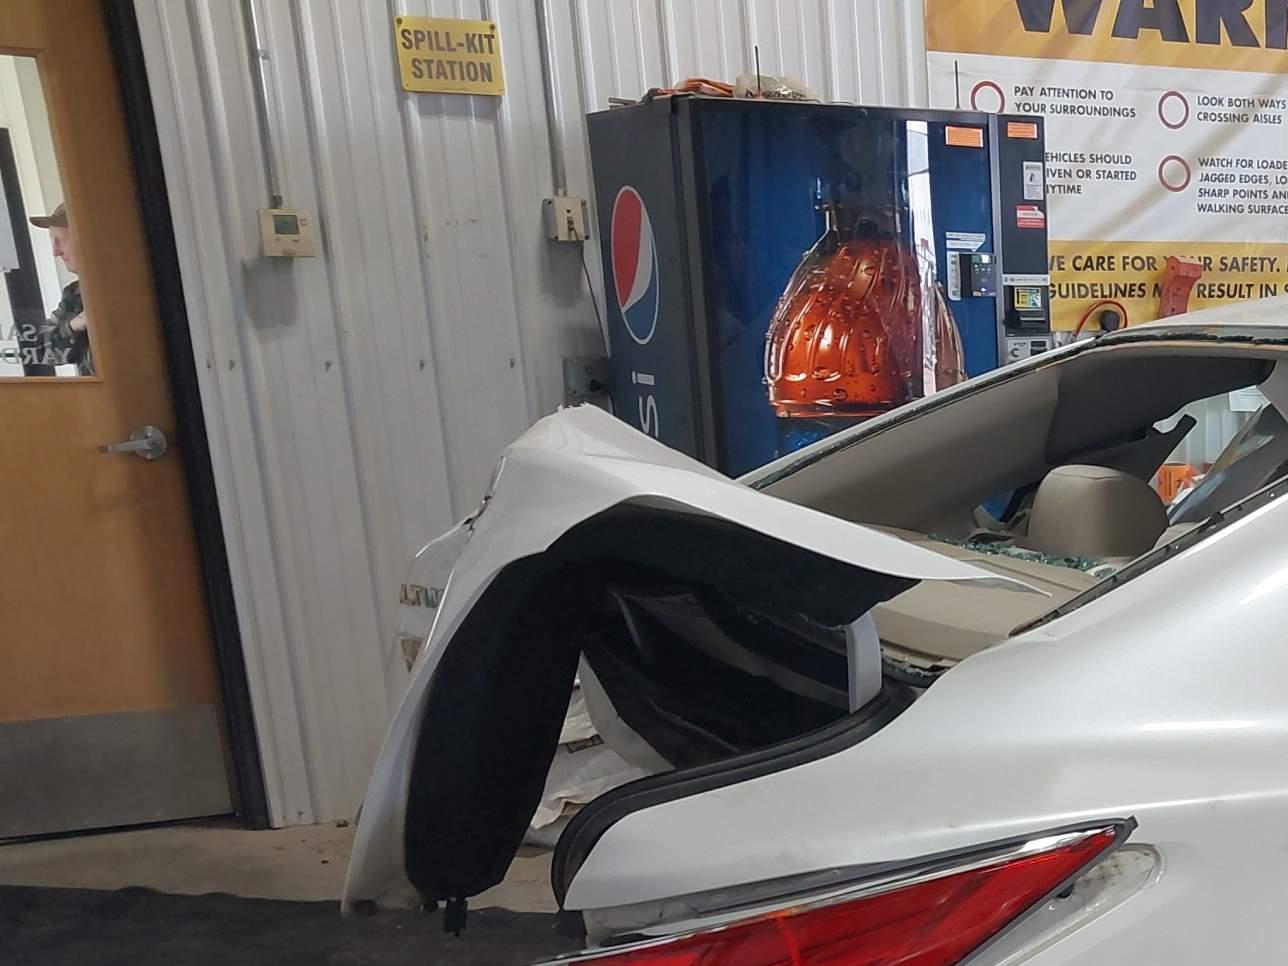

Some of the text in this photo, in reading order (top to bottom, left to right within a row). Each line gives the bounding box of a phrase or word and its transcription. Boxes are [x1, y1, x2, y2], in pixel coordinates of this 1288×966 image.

[401, 29, 495, 54] SPILL-KIT
[411, 58, 493, 82] STATION
[1014, 86, 1114, 100] PAY ATTENTION TO
[1197, 96, 1224, 107] LOOK
[1228, 98, 1255, 108] BOTH
[1258, 99, 1287, 109] WAYS
[1014, 102, 1136, 117] YOUR SURROUNDINGS
[1197, 111, 1282, 124] CROSSING AISLES
[1089, 153, 1132, 164] SHOULD
[1198, 157, 1233, 168] WATCH
[1235, 158, 1253, 168] FOR
[1076, 169, 1092, 179] OR
[1095, 170, 1137, 180] STARTED
[1199, 172, 1236, 183] JAGGED
[1239, 174, 1272, 186] EDGES,
[1198, 187, 1229, 198] SHARP
[1232, 189, 1268, 199] POINTS
[1197, 203, 1244, 213] WALKING
[1072, 255, 1115, 271] CARE
[1122, 255, 1158, 271] FOR
[1219, 256, 1280, 273] SAFETY.
[1197, 283, 1254, 299] RESULT
[1259, 283, 1277, 298] IN
